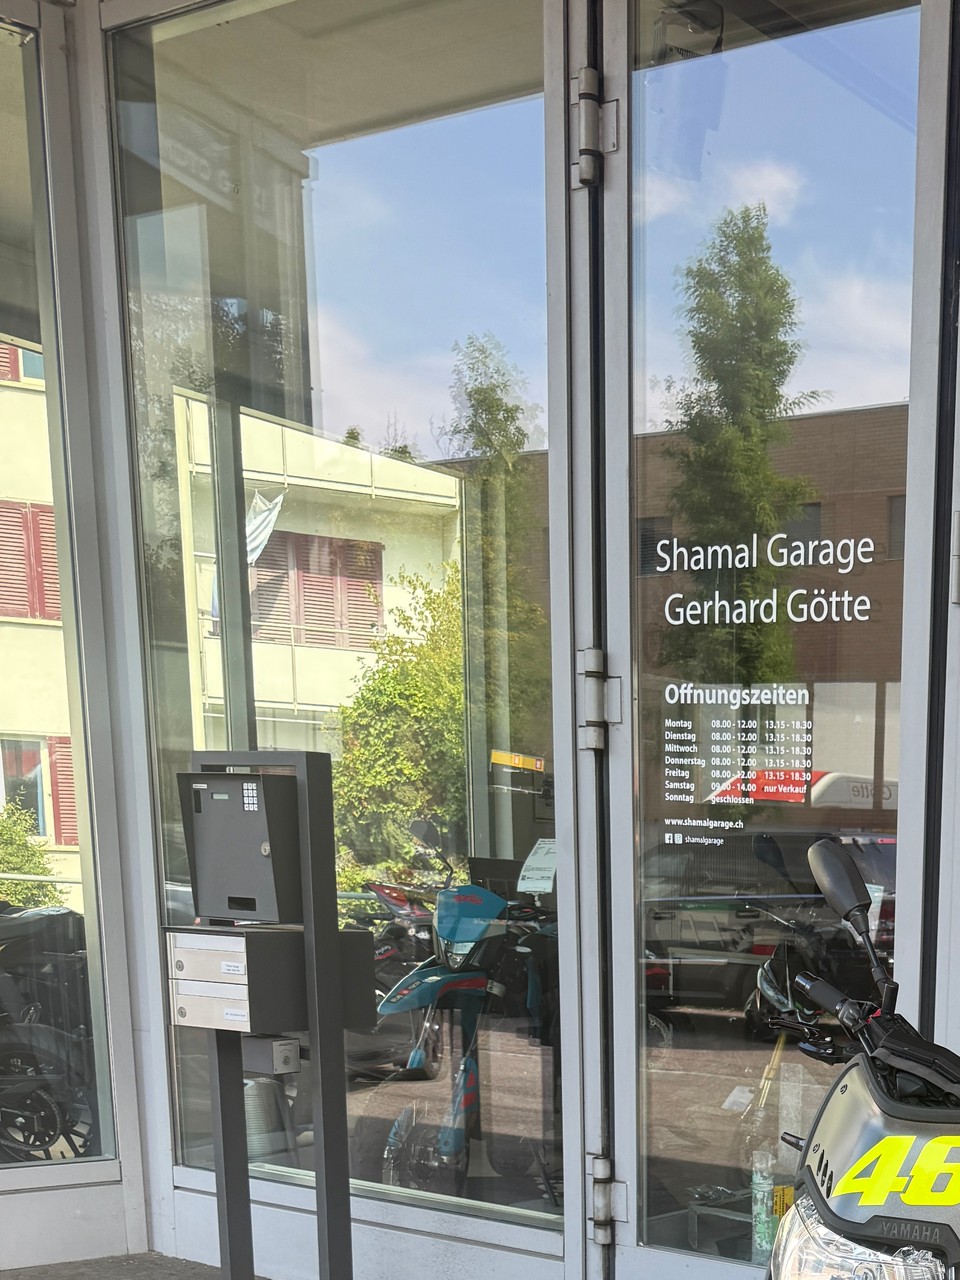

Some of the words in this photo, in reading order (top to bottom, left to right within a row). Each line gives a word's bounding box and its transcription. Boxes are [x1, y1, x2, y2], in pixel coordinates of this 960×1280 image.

[655, 533, 758, 572] Shamal
[766, 533, 875, 574] Garage
[664, 588, 778, 626] Gerhard
[786, 588, 871, 623] Götte
[664, 719, 693, 729] Montag
[711, 720, 731, 728] 08.00
[737, 720, 757, 728] 12.00
[764, 721, 785, 729] 13.15
[791, 721, 812, 729] 18.30
[664, 731, 697, 742] Dienstag
[711, 732, 731, 741] 08.00
[737, 733, 757, 741] 12.00
[764, 733, 785, 742] 13.15
[791, 734, 812, 742] 18.30
[664, 744, 698, 753] Mittwoch
[711, 745, 731, 753] 08.00
[737, 745, 757, 754] 12.00
[764, 746, 785, 754] 13.15
[791, 746, 812, 755] 18.30
[664, 756, 706, 768] Donnerstag
[711, 757, 731, 766] 08.00
[737, 758, 757, 766] 12.00
[764, 759, 785, 767] 13.15
[791, 759, 812, 768] 18.30
[664, 768, 690, 779] Freitag
[711, 770, 731, 778] 08.00
[764, 771, 785, 780] 13.15
[791, 772, 812, 781] 18.30
[664, 780, 695, 791] Samstag
[711, 782, 731, 791] 090
[737, 783, 757, 792] 14.00
[778, 784, 807, 794] Verkauf
[664, 792, 695, 803] Sonntag
[711, 795, 755, 805] geschlossen
[664, 817, 744, 830] www.shamalgarage.ch
[684, 835, 724, 847] shamalgarage
[882, 1221, 940, 1244] YAMAHA
